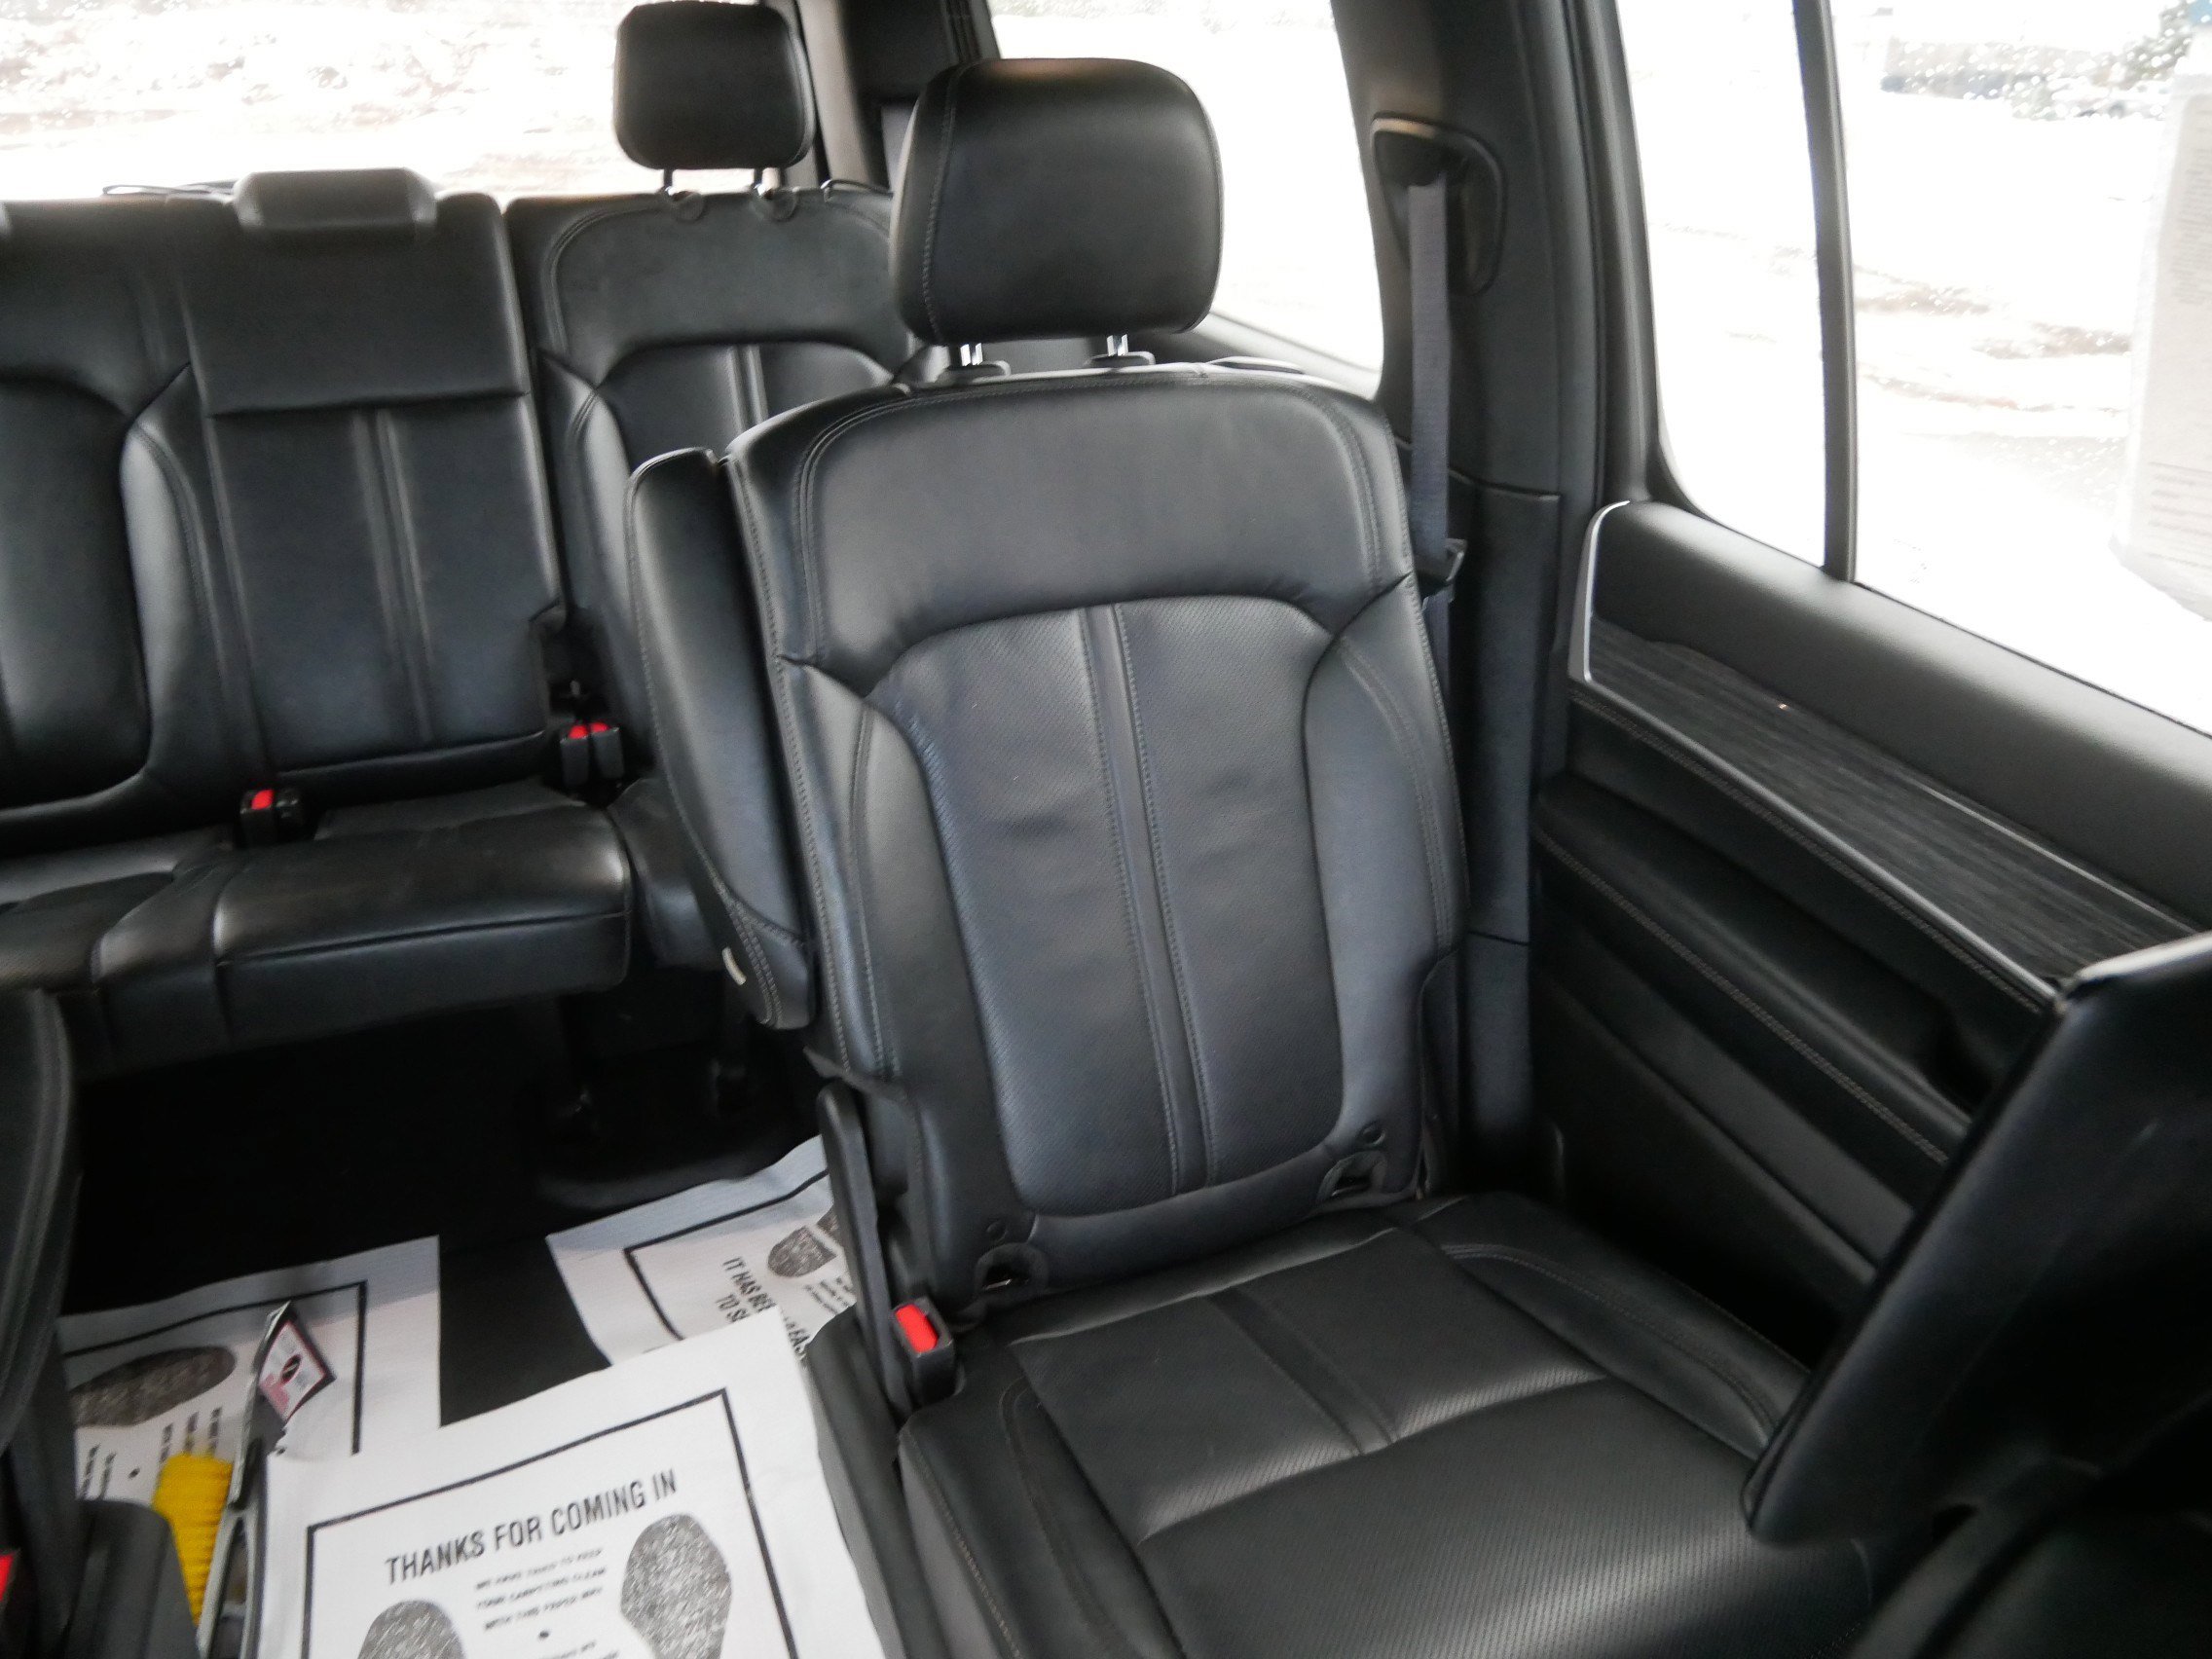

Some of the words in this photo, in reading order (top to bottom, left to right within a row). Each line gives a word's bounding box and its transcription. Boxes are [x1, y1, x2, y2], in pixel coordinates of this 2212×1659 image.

[722, 1256, 745, 1271] IT
[731, 1271, 762, 1295] HAS
[386, 1530, 485, 1585] THANKS
[494, 1515, 542, 1553] FOR
[550, 1480, 646, 1537] COMING
[651, 1468, 678, 1502] IN
